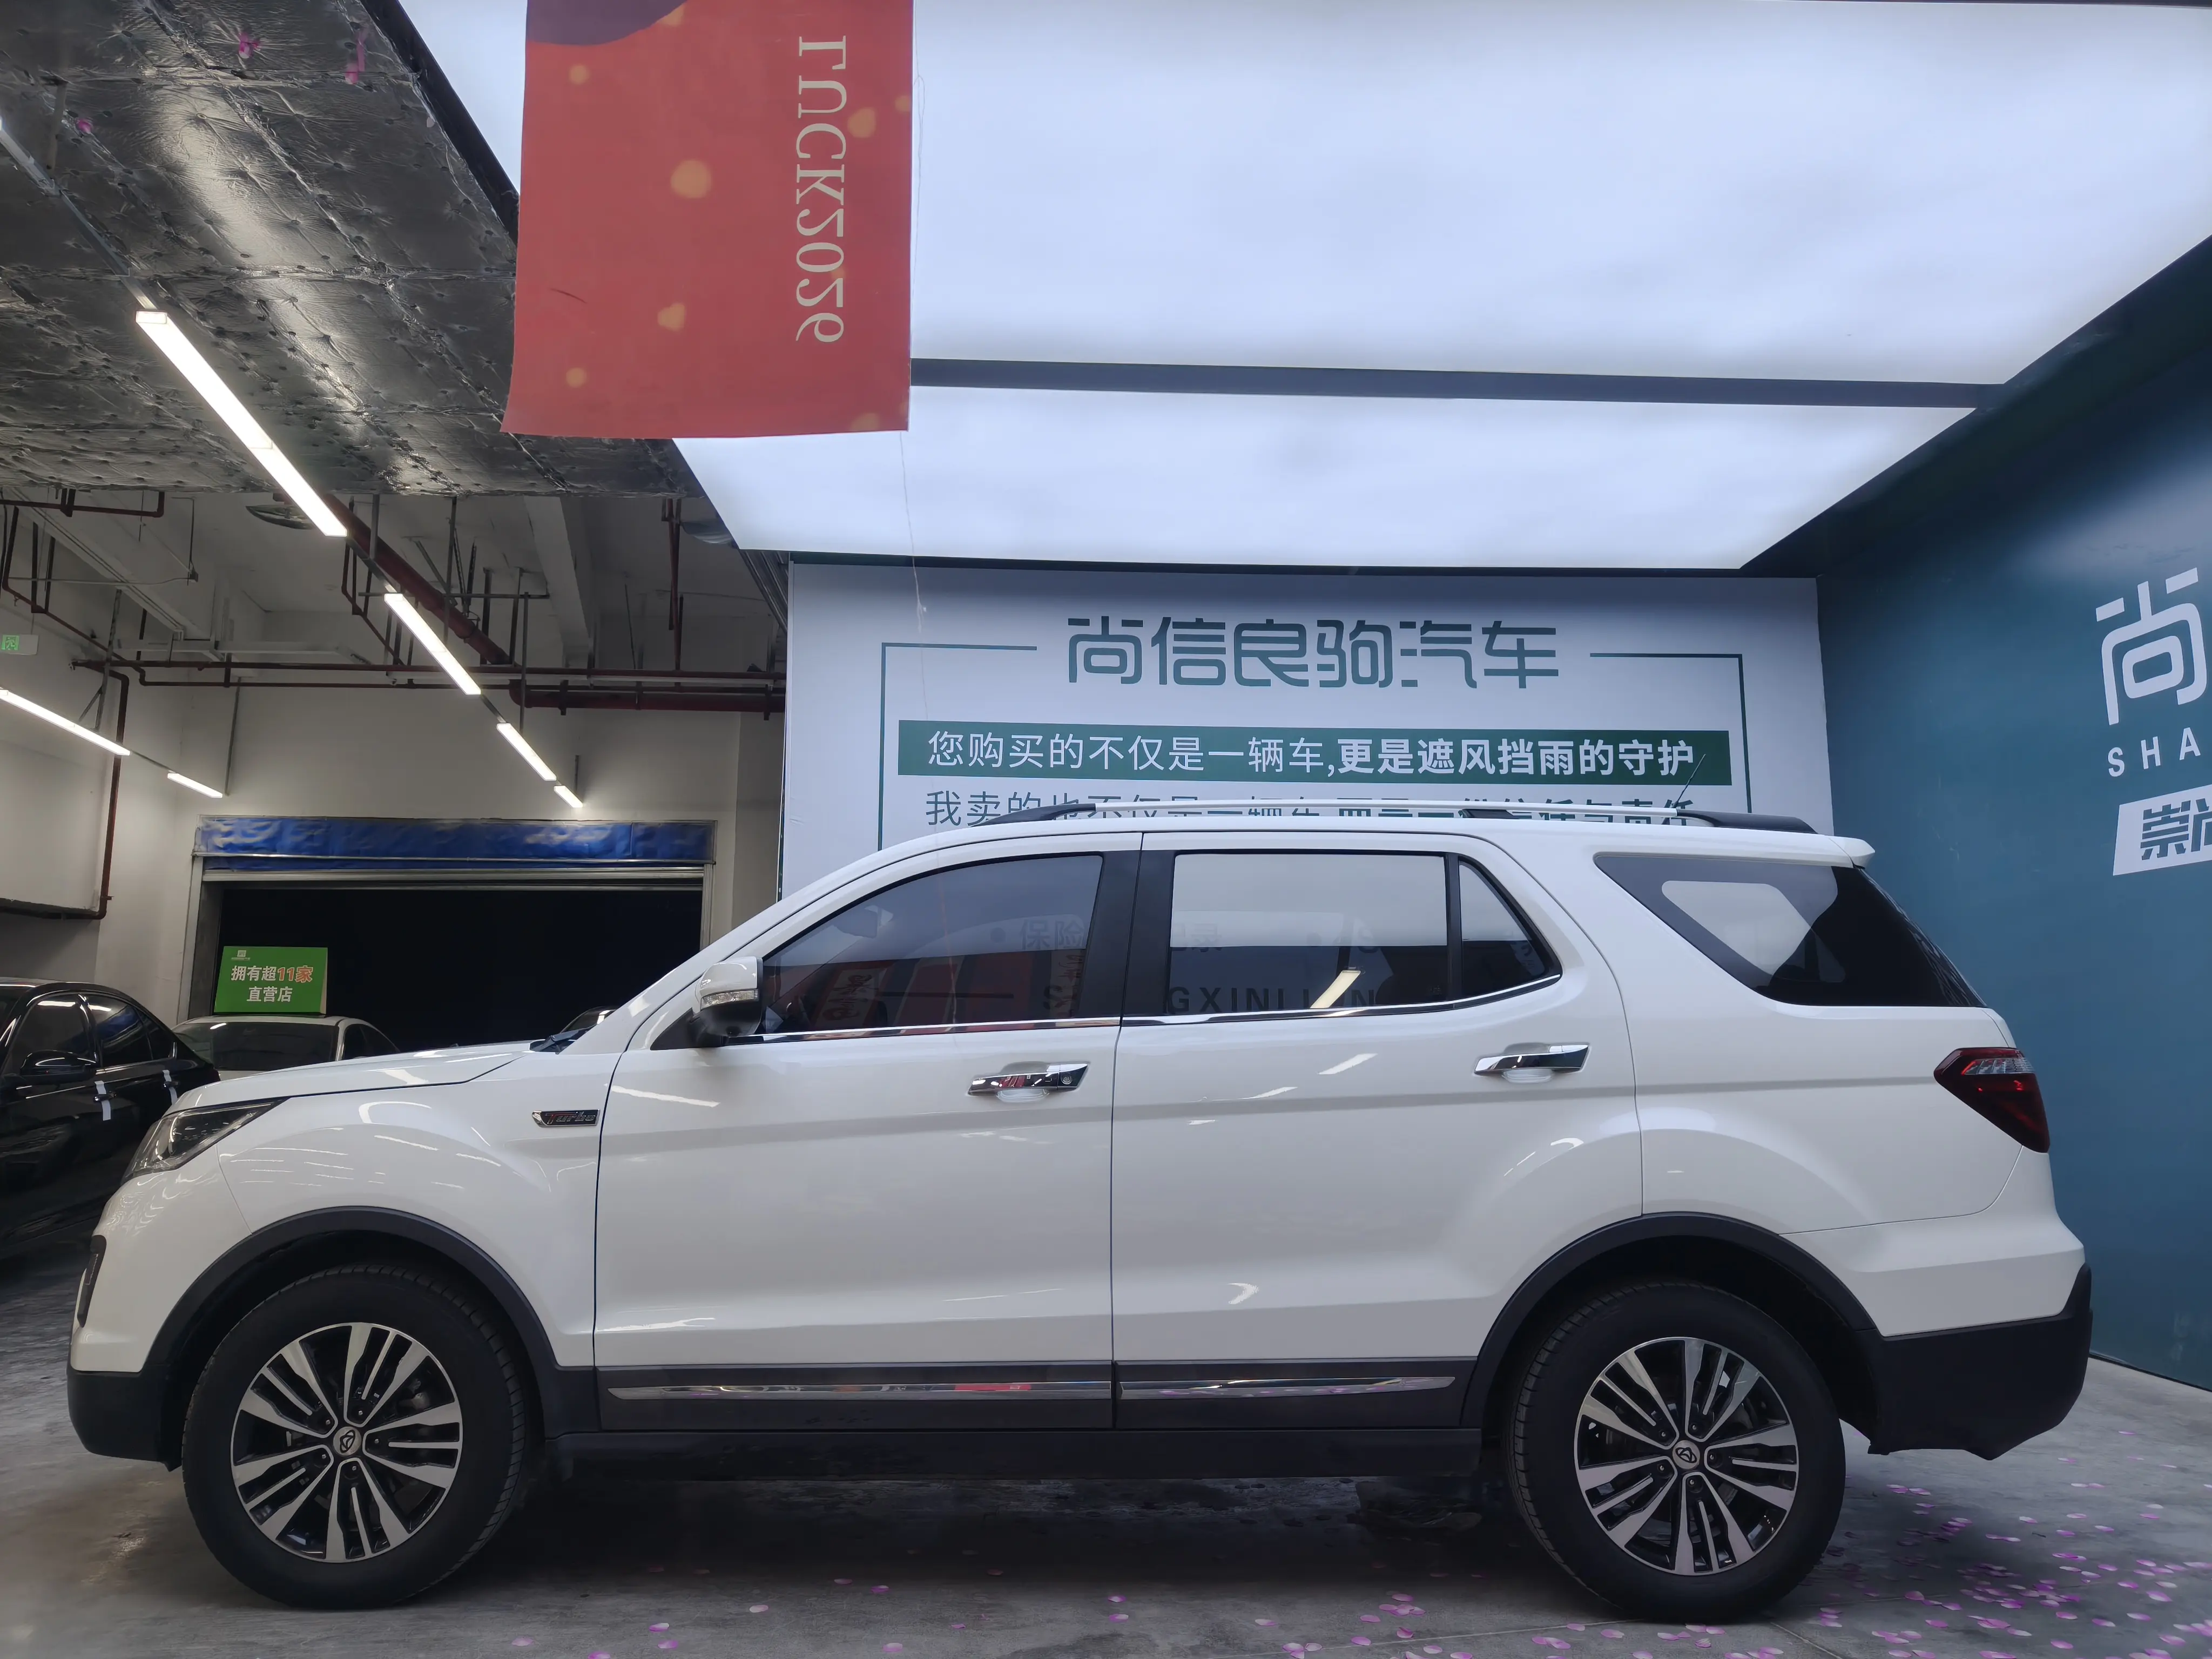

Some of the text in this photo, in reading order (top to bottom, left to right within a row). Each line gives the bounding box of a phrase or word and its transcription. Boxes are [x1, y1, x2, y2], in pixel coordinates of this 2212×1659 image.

[1067, 616, 1559, 689] 尚信良驹汽车
[2095, 567, 2207, 726] 尚
[2107, 727, 2201, 777] SHA
[231, 965, 314, 983] 拥有超11家
[247, 986, 293, 1002] 直营店
[545, 1111, 596, 1124] Turbo
